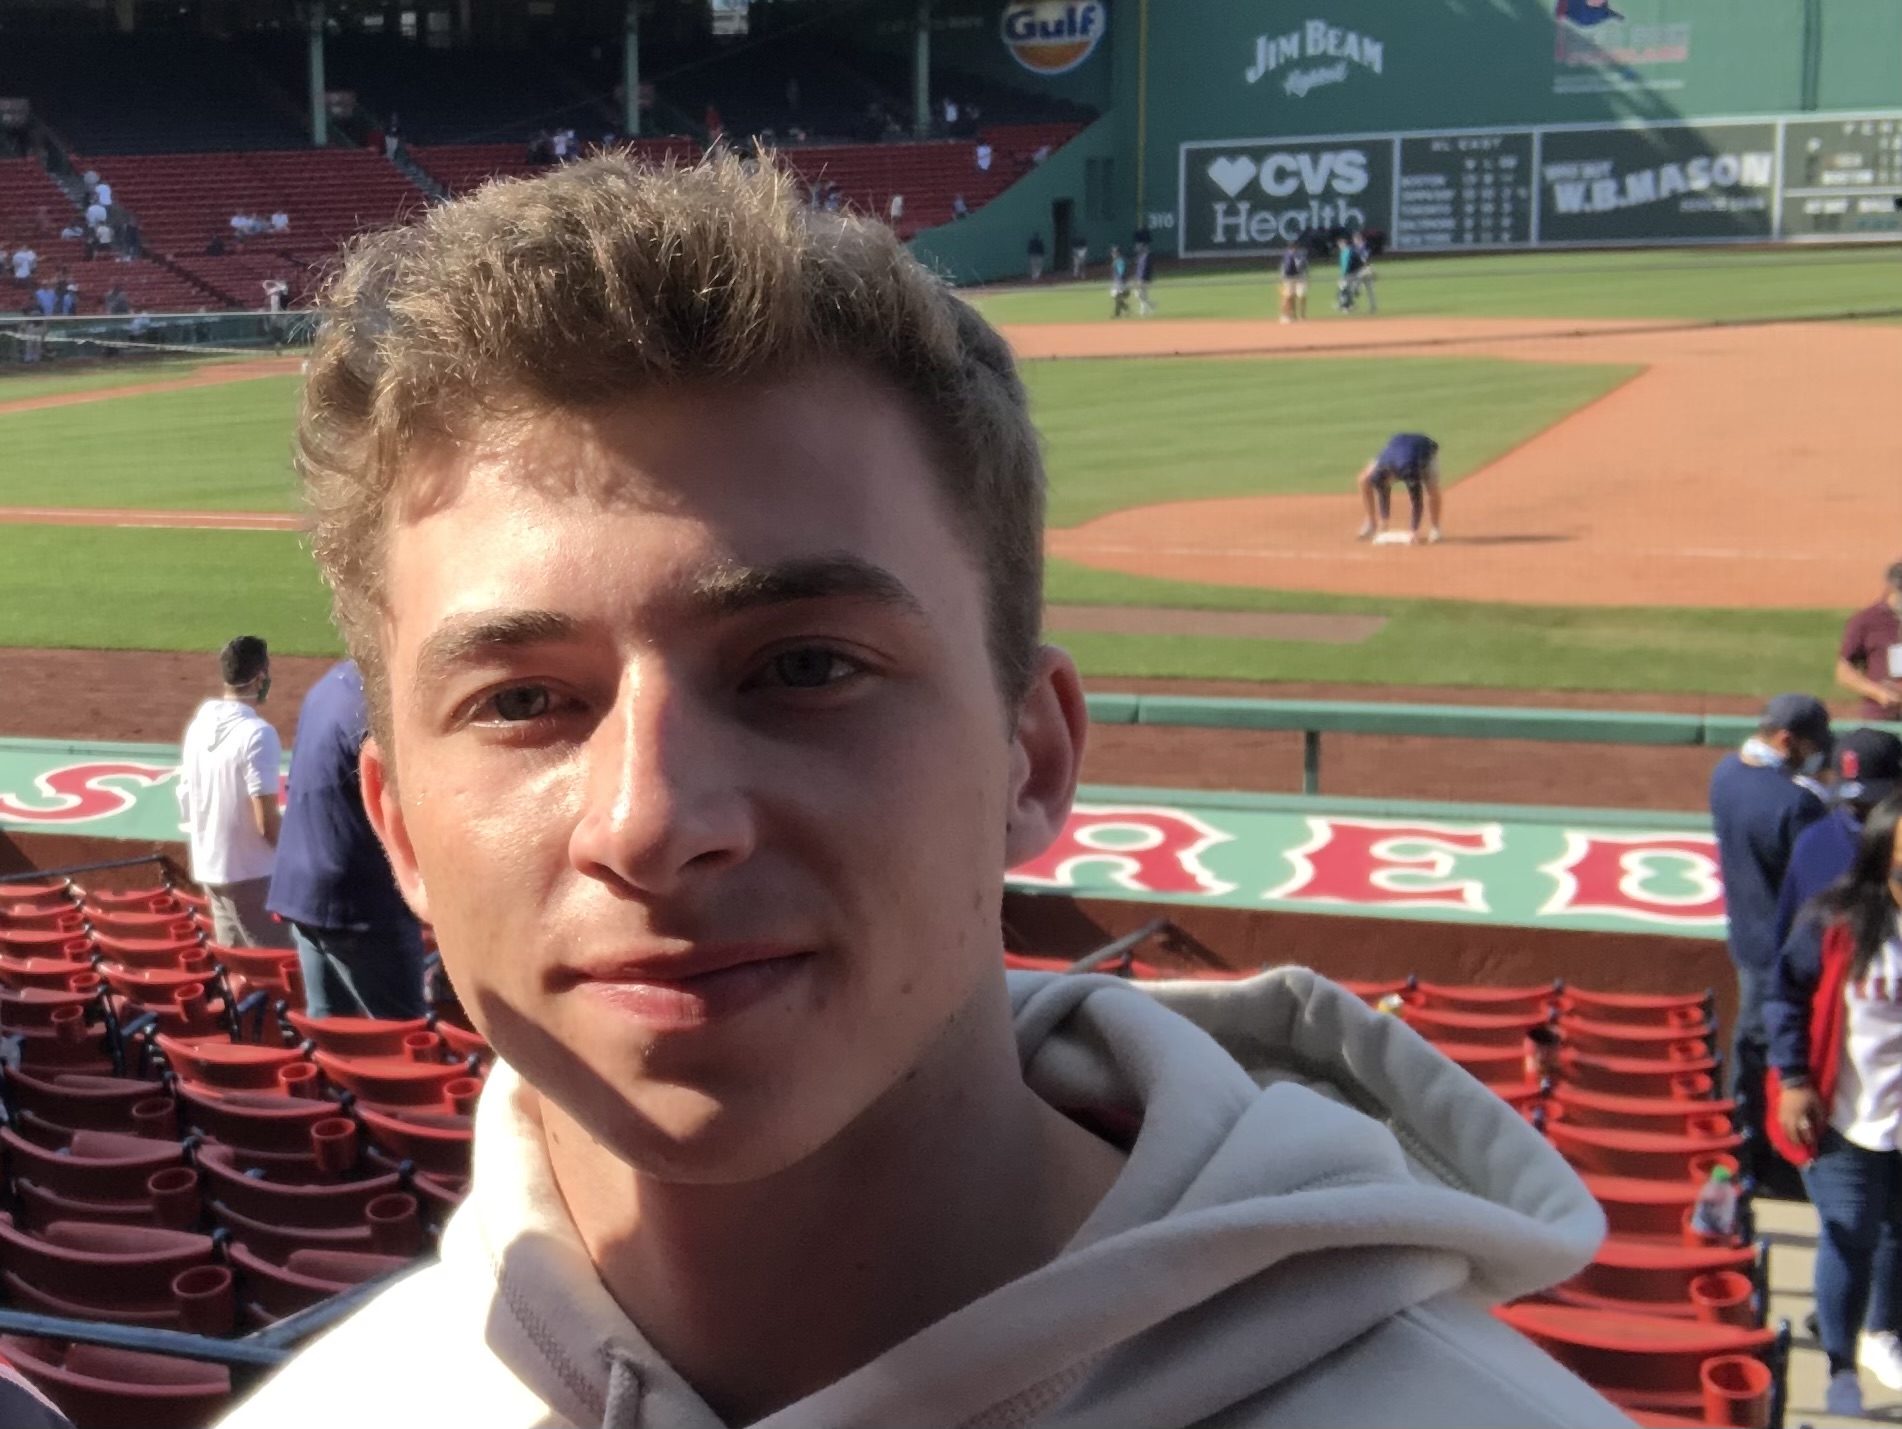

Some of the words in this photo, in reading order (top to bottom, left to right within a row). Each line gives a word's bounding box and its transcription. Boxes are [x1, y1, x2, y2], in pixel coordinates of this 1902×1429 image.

[1005, 4, 1096, 40] Gulf
[1245, 33, 1299, 83] JIM
[1305, 19, 1384, 74] BEAM
[1259, 151, 1368, 196] CVS
